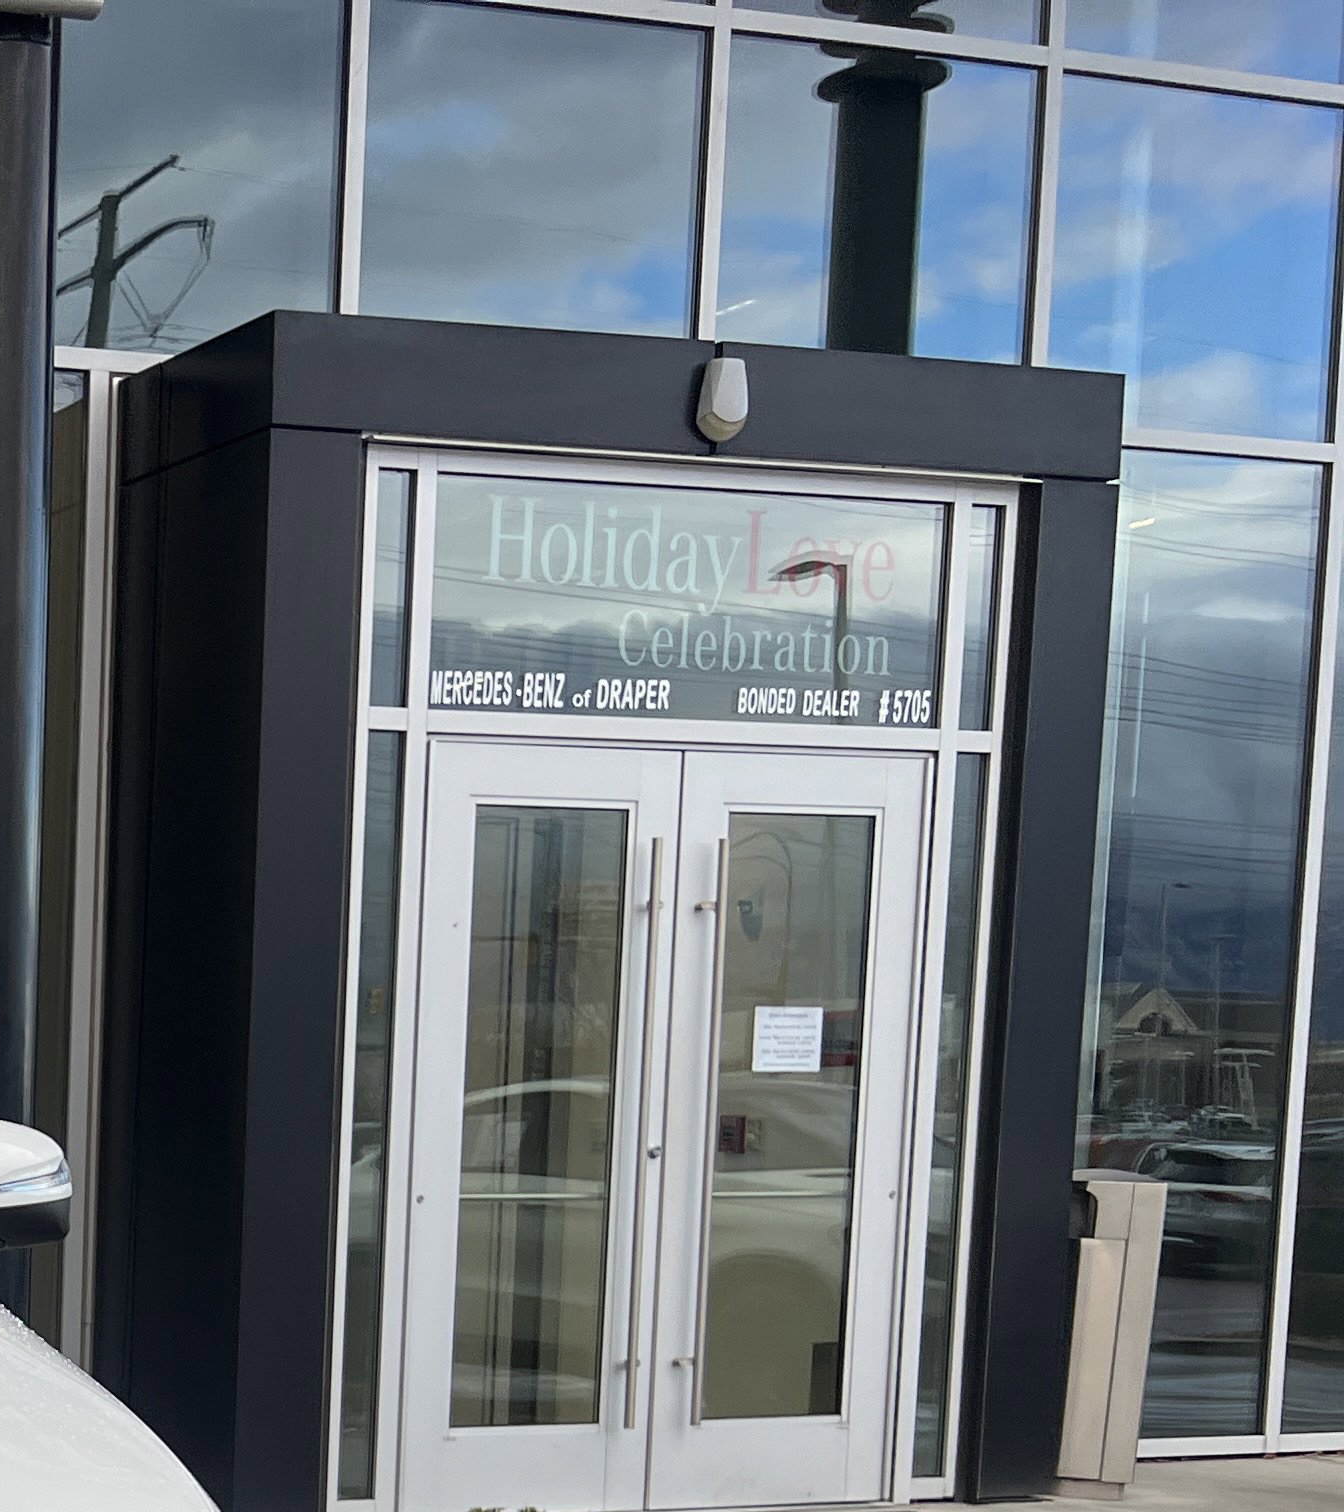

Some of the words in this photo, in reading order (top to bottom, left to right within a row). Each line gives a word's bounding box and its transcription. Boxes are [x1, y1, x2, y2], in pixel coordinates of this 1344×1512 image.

[618, 609, 891, 676] Celebration
[572, 689, 593, 709] of
[596, 679, 671, 710] DRAPER
[737, 687, 796, 715] BONDED
[802, 690, 860, 717] DEALER
